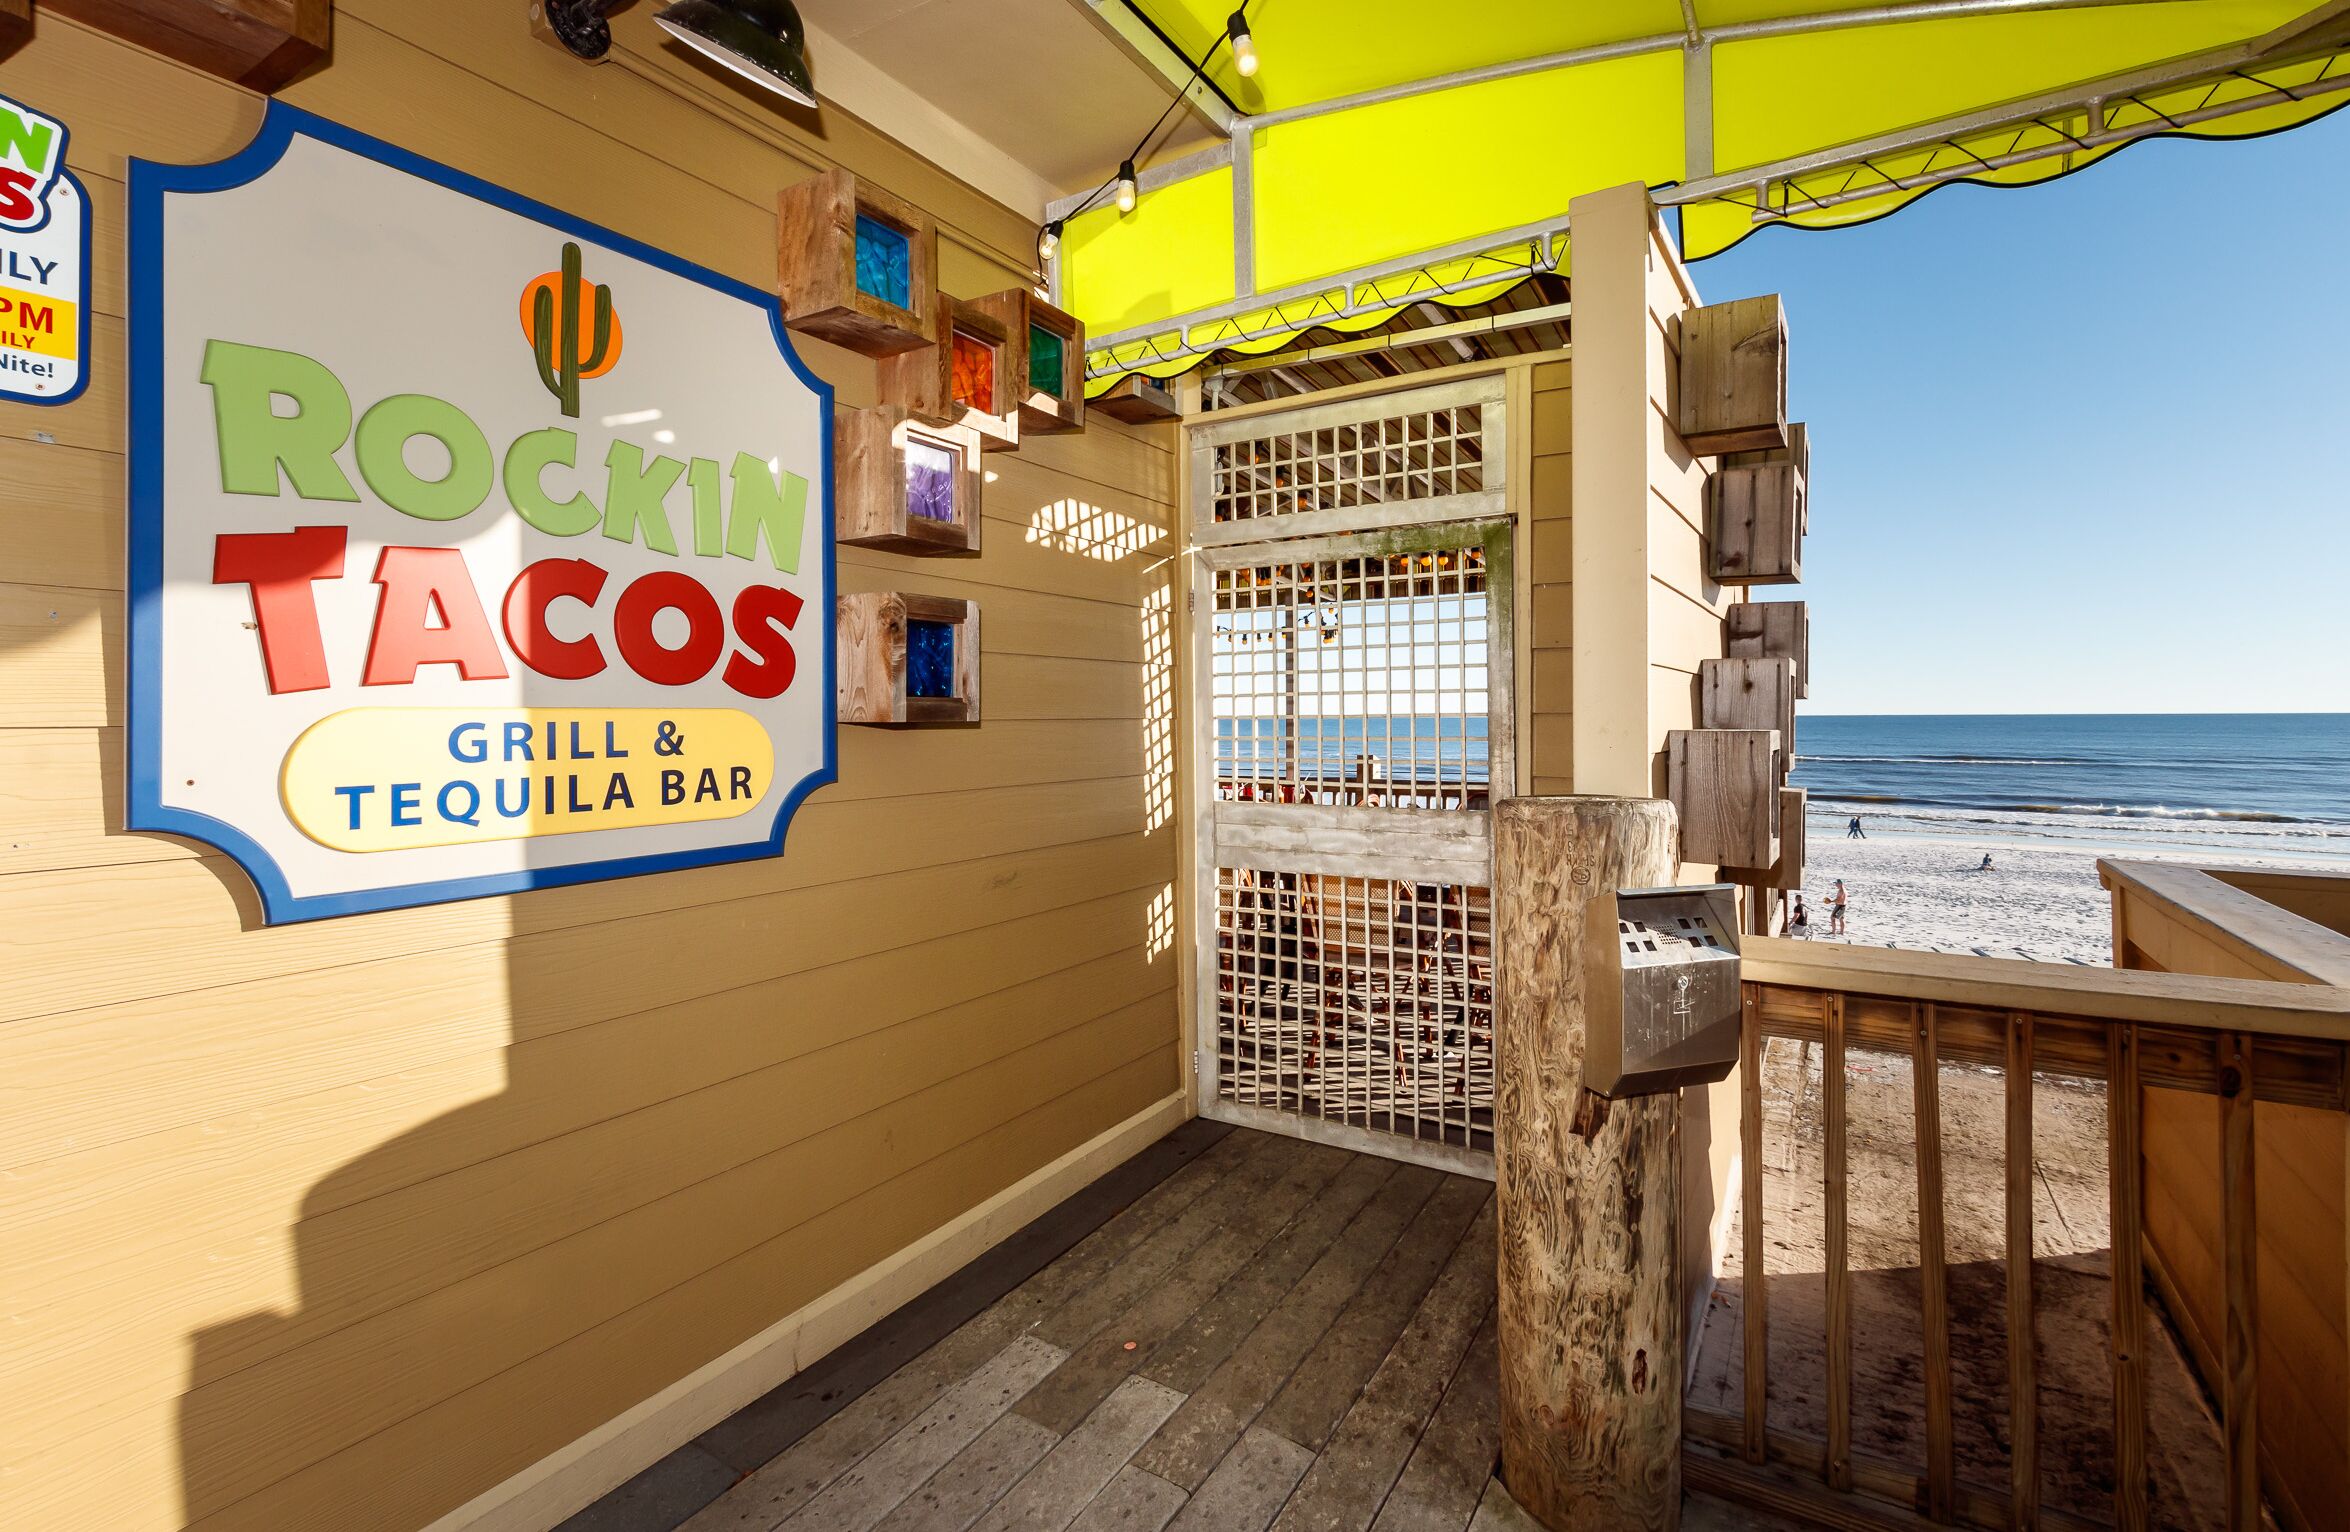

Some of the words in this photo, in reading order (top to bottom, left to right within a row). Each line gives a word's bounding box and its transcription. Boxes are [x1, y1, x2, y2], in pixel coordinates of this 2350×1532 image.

[0, 248, 58, 285] LY
[200, 338, 808, 575] ROCKIN
[212, 524, 804, 699] TACOS
[448, 720, 629, 764] GRILL
[653, 720, 684, 756] &
[334, 771, 635, 831] TEQUILA
[661, 765, 752, 806] BAR
